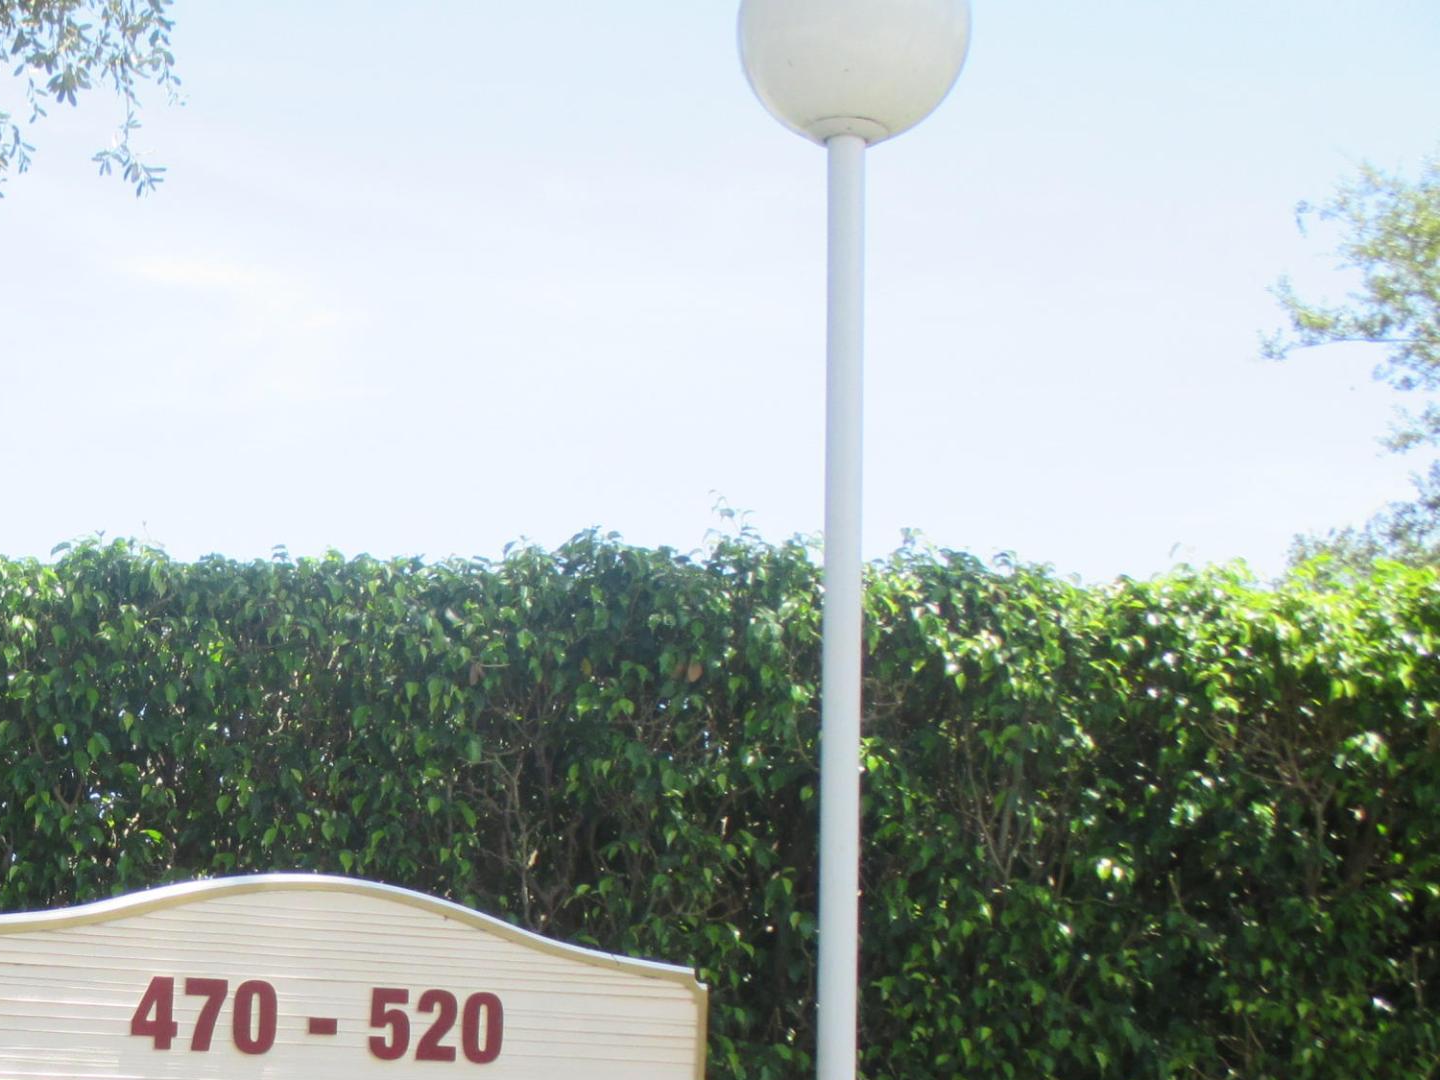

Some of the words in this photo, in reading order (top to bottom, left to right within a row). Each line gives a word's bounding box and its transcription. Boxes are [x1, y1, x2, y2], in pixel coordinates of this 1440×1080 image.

[130, 976, 278, 1055] 470
[308, 1017, 338, 1036] -
[368, 987, 504, 1065] 520
